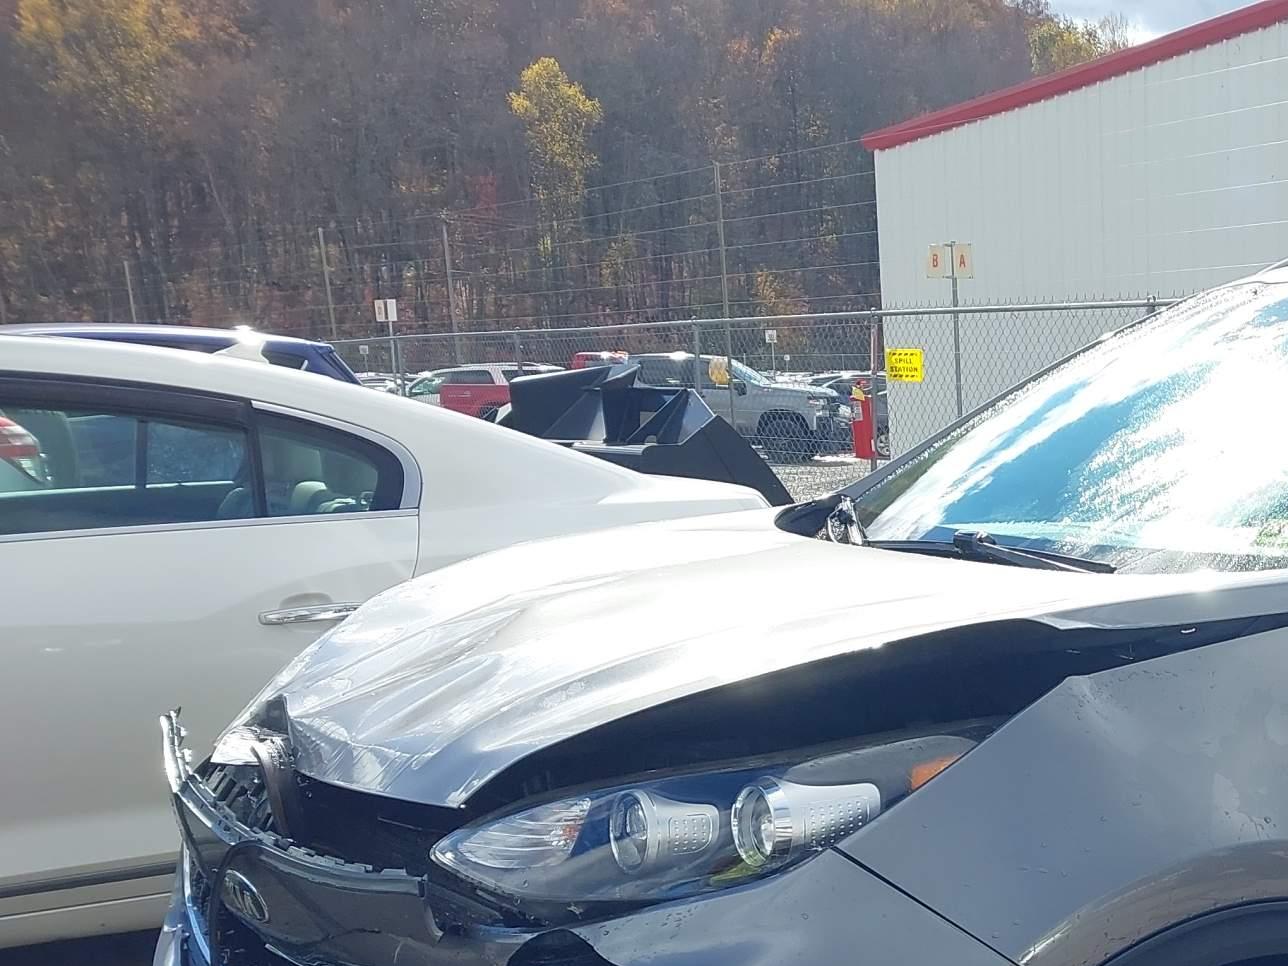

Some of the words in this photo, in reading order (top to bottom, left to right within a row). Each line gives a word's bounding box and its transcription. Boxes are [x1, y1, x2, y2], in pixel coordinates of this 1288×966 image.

[932, 253, 938, 268] B
[959, 254, 966, 268] A
[889, 365, 918, 373] STATION
